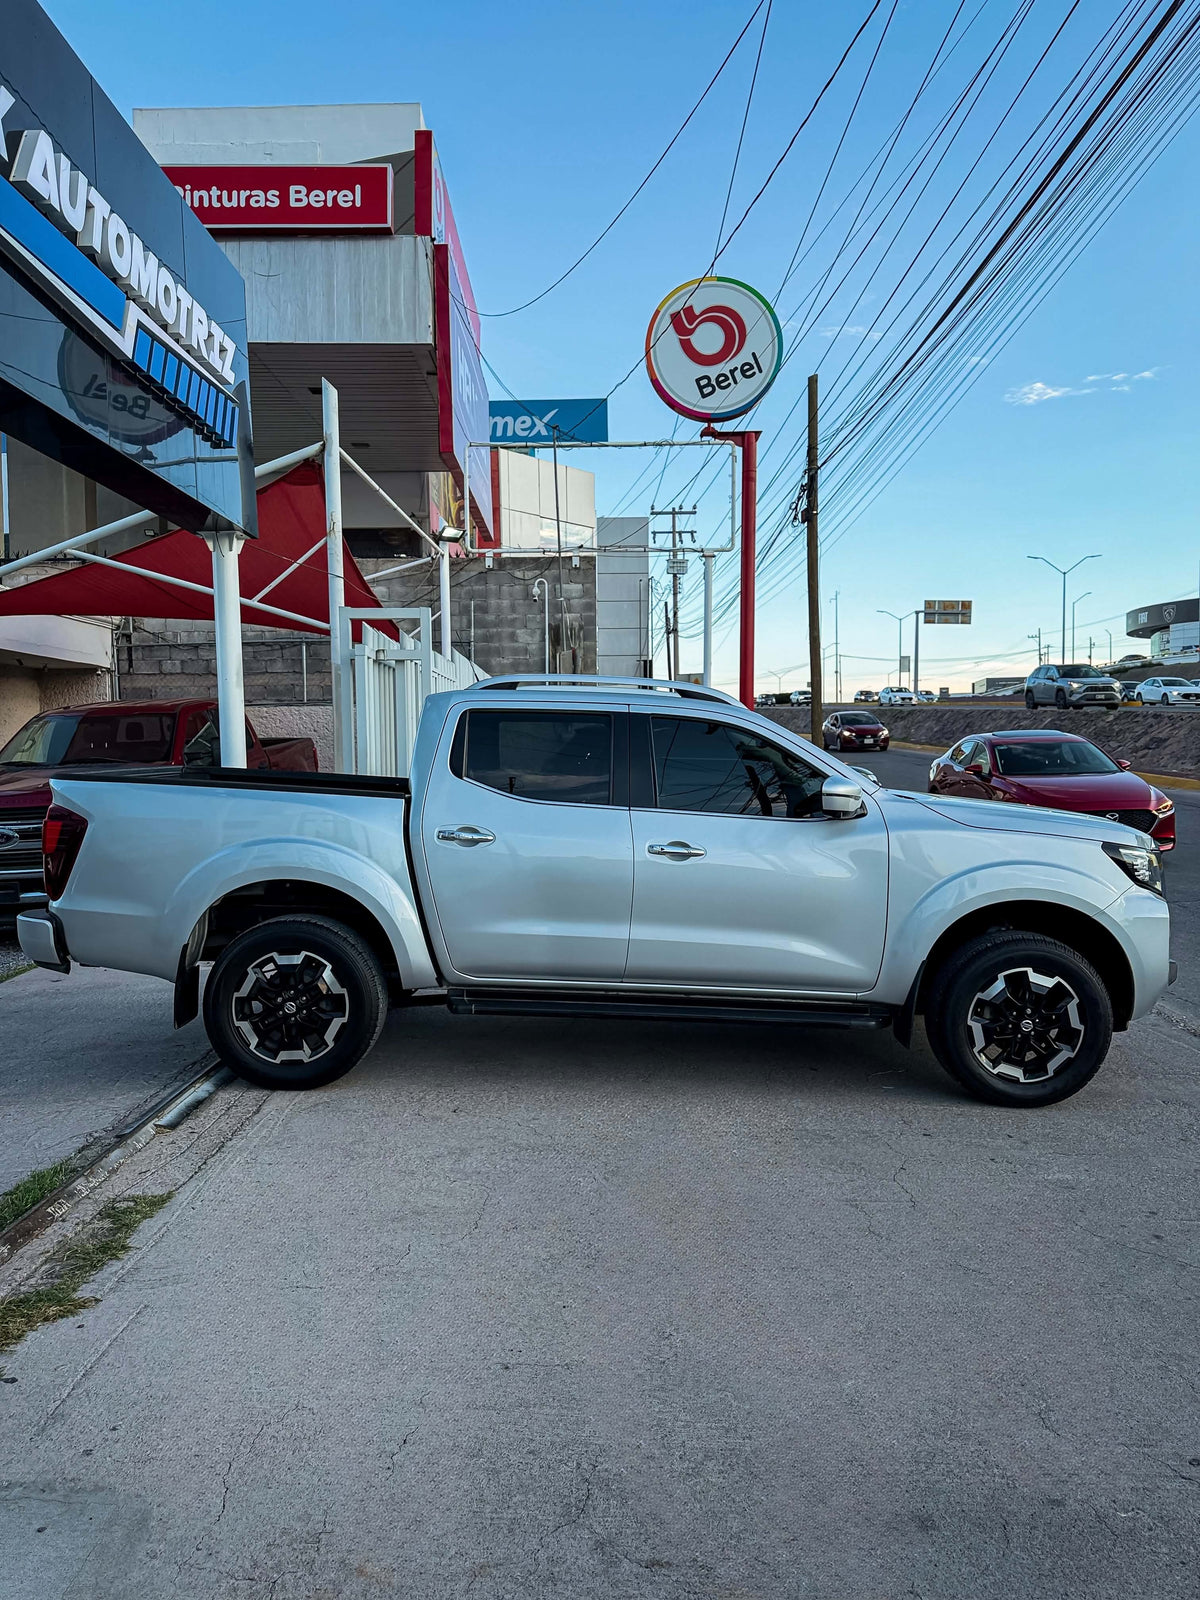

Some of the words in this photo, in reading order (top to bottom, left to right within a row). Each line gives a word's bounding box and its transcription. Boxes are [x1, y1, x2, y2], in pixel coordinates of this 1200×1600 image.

[288, 184, 362, 208] Berel
[10, 129, 236, 385] AUTOMOTRIZ
[694, 351, 763, 399] Berel
